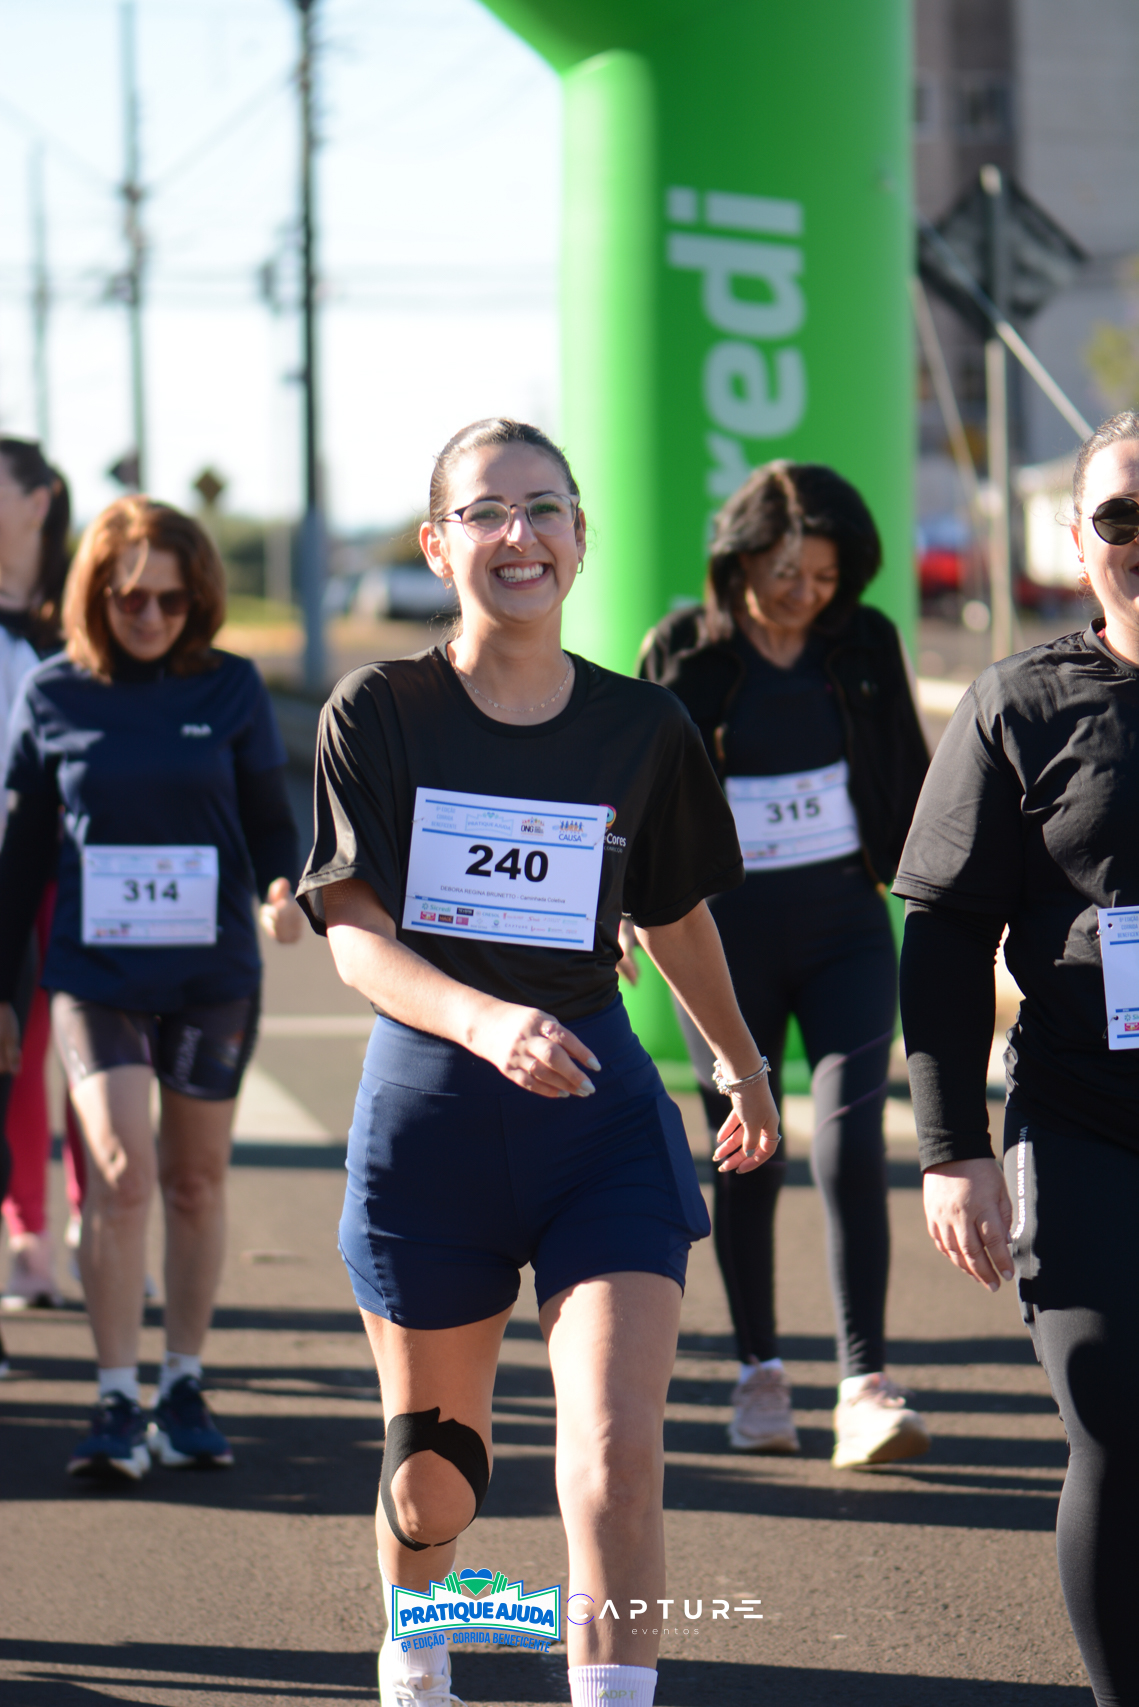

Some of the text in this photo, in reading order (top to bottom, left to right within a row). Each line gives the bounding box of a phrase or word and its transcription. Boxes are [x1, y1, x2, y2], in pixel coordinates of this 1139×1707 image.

[666, 185, 805, 500] redi
[766, 797, 820, 824] 315
[520, 824, 534, 833] ONG
[558, 833, 582, 843] CAUSA
[604, 833, 627, 847] Cores
[465, 844, 549, 882] 240
[123, 879, 179, 902] 314
[440, 885, 463, 893] DEBORA
[464, 888, 485, 896] REGINA
[486, 891, 516, 899] BRUNETTO
[520, 894, 546, 902] Caminhada
[547, 896, 566, 904] Coletiva
[1017, 1126, 1028, 1169] WOMEN
[1017, 1169, 1025, 1197] WHO
[598, 1690, 636, 1699] ADPT
